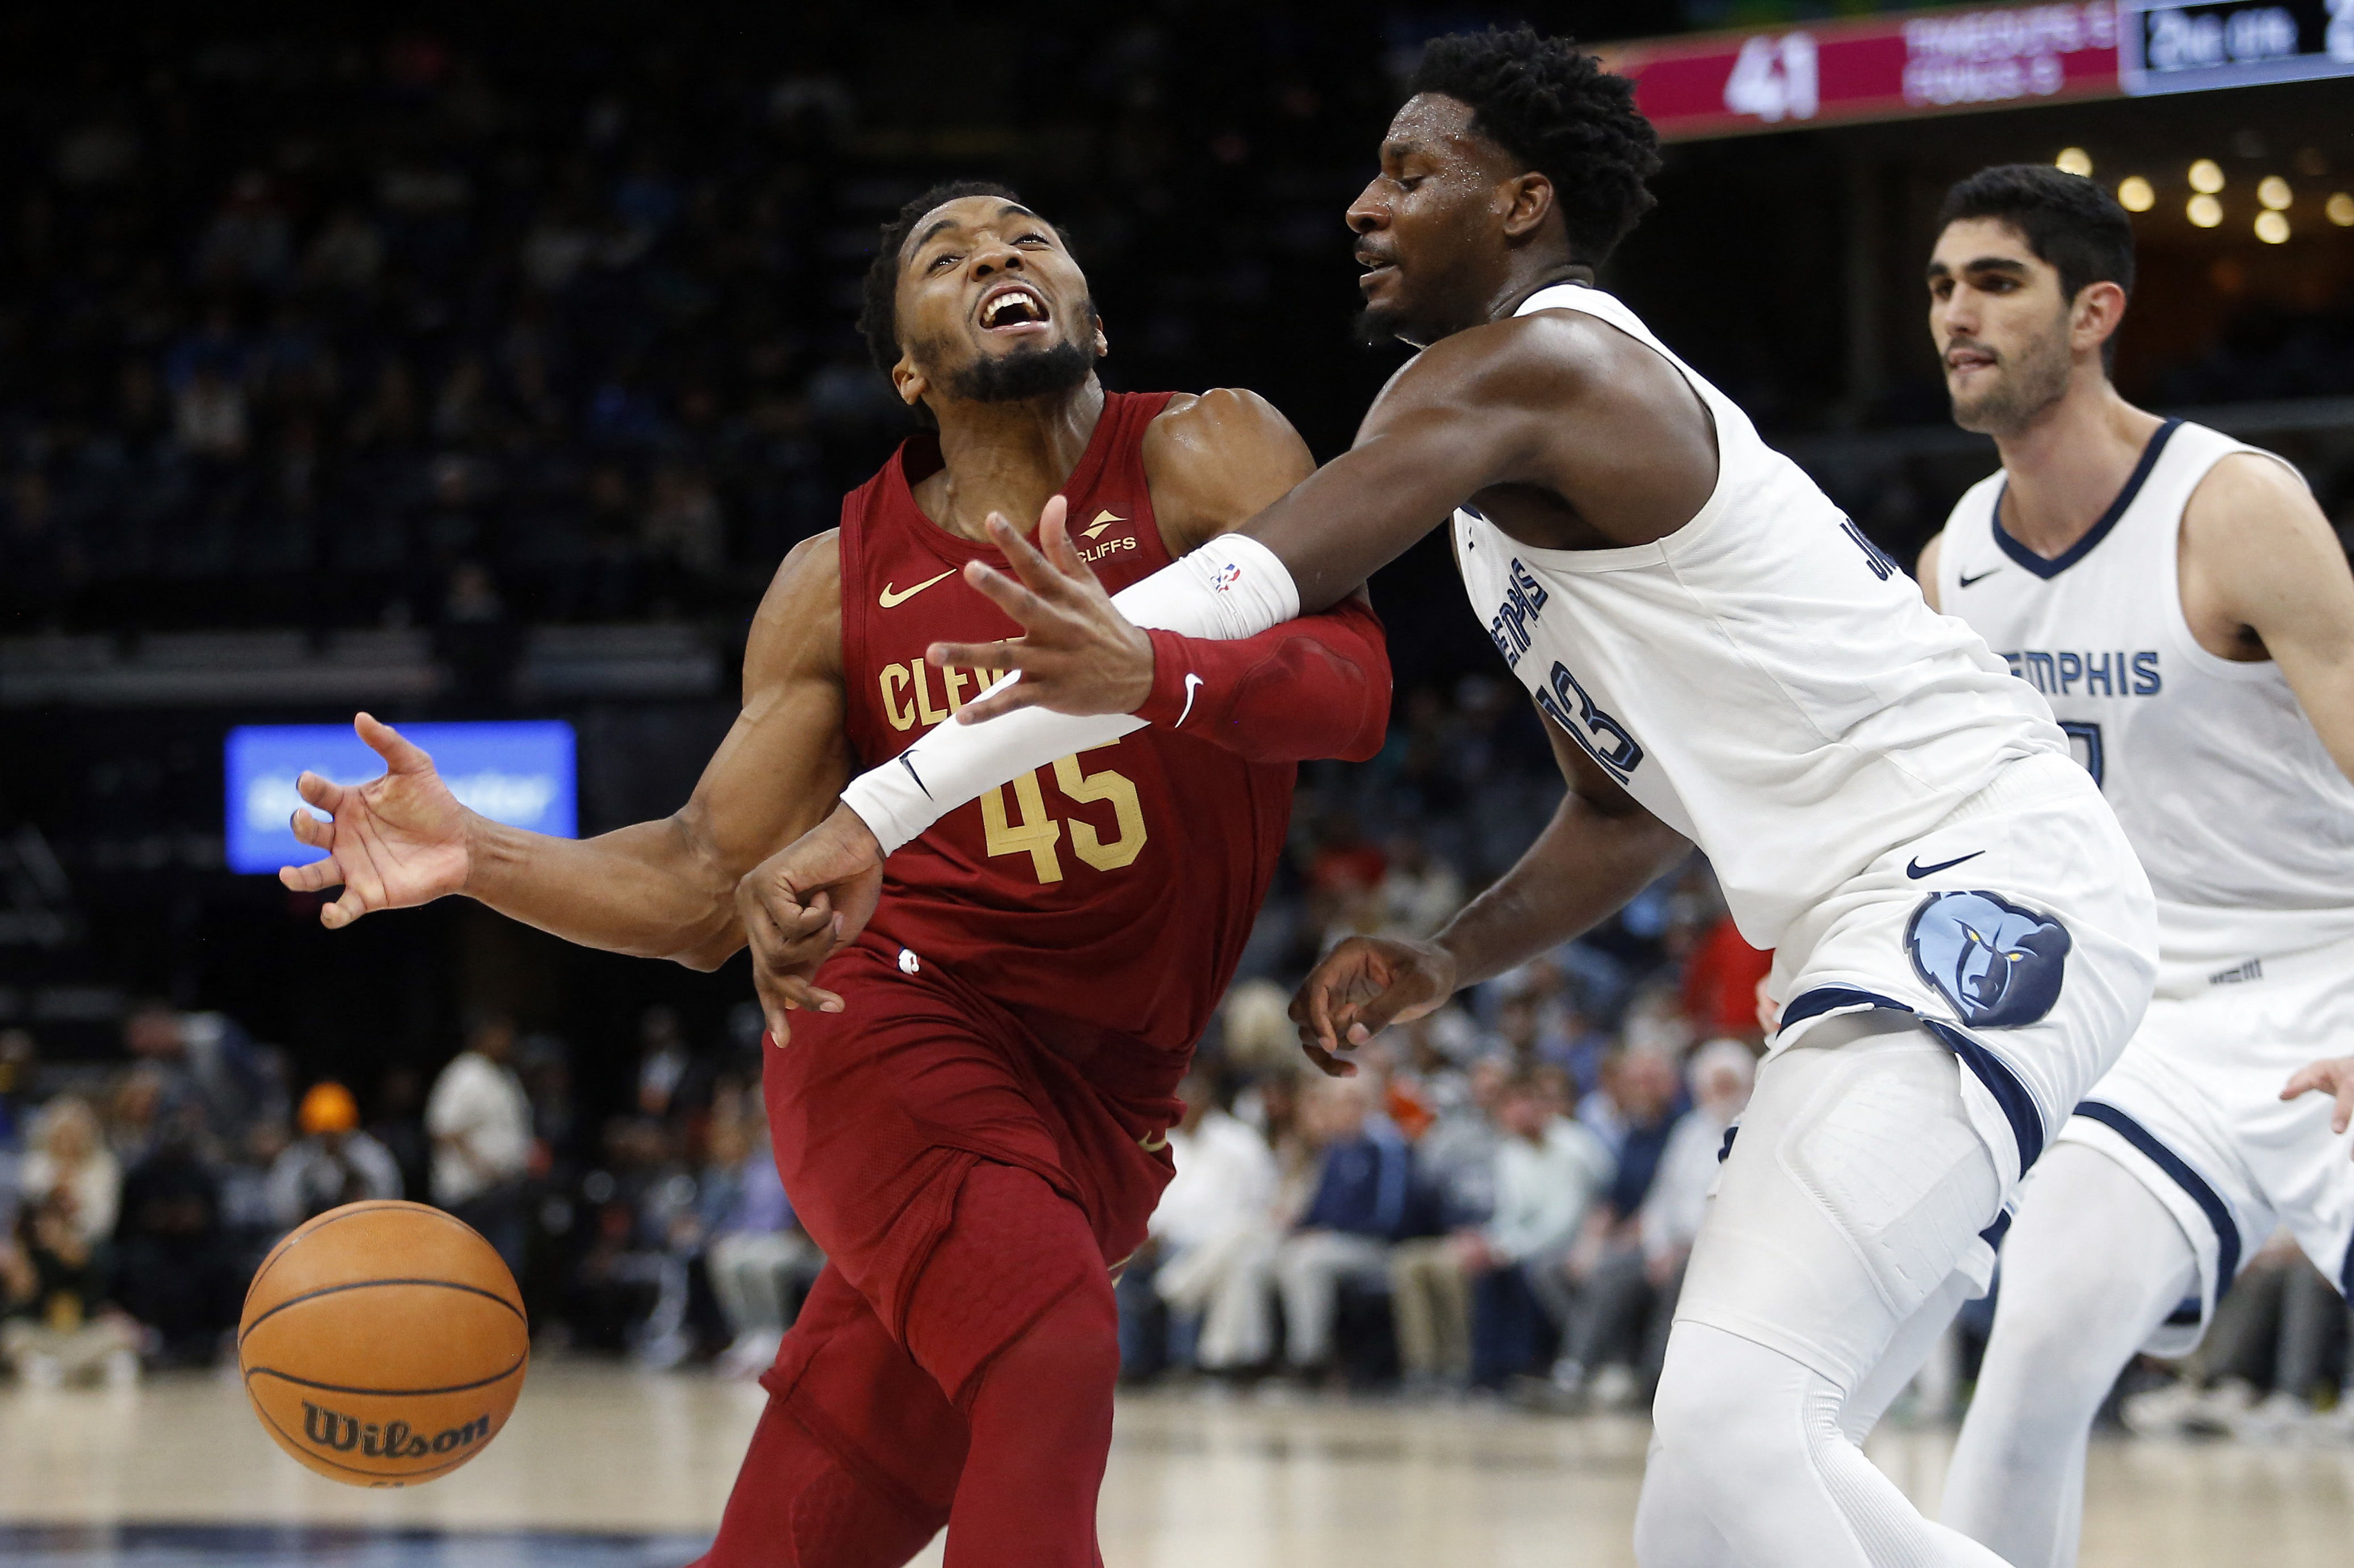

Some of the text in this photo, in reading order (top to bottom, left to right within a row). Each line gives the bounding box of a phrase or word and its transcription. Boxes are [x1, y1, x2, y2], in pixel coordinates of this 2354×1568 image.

[1723, 32, 1819, 124] 41
[1077, 537, 1137, 563] CLIFFS
[1535, 661, 1644, 780] 13
[980, 738, 1148, 884] 45
[301, 1398, 490, 1458] Wilson
